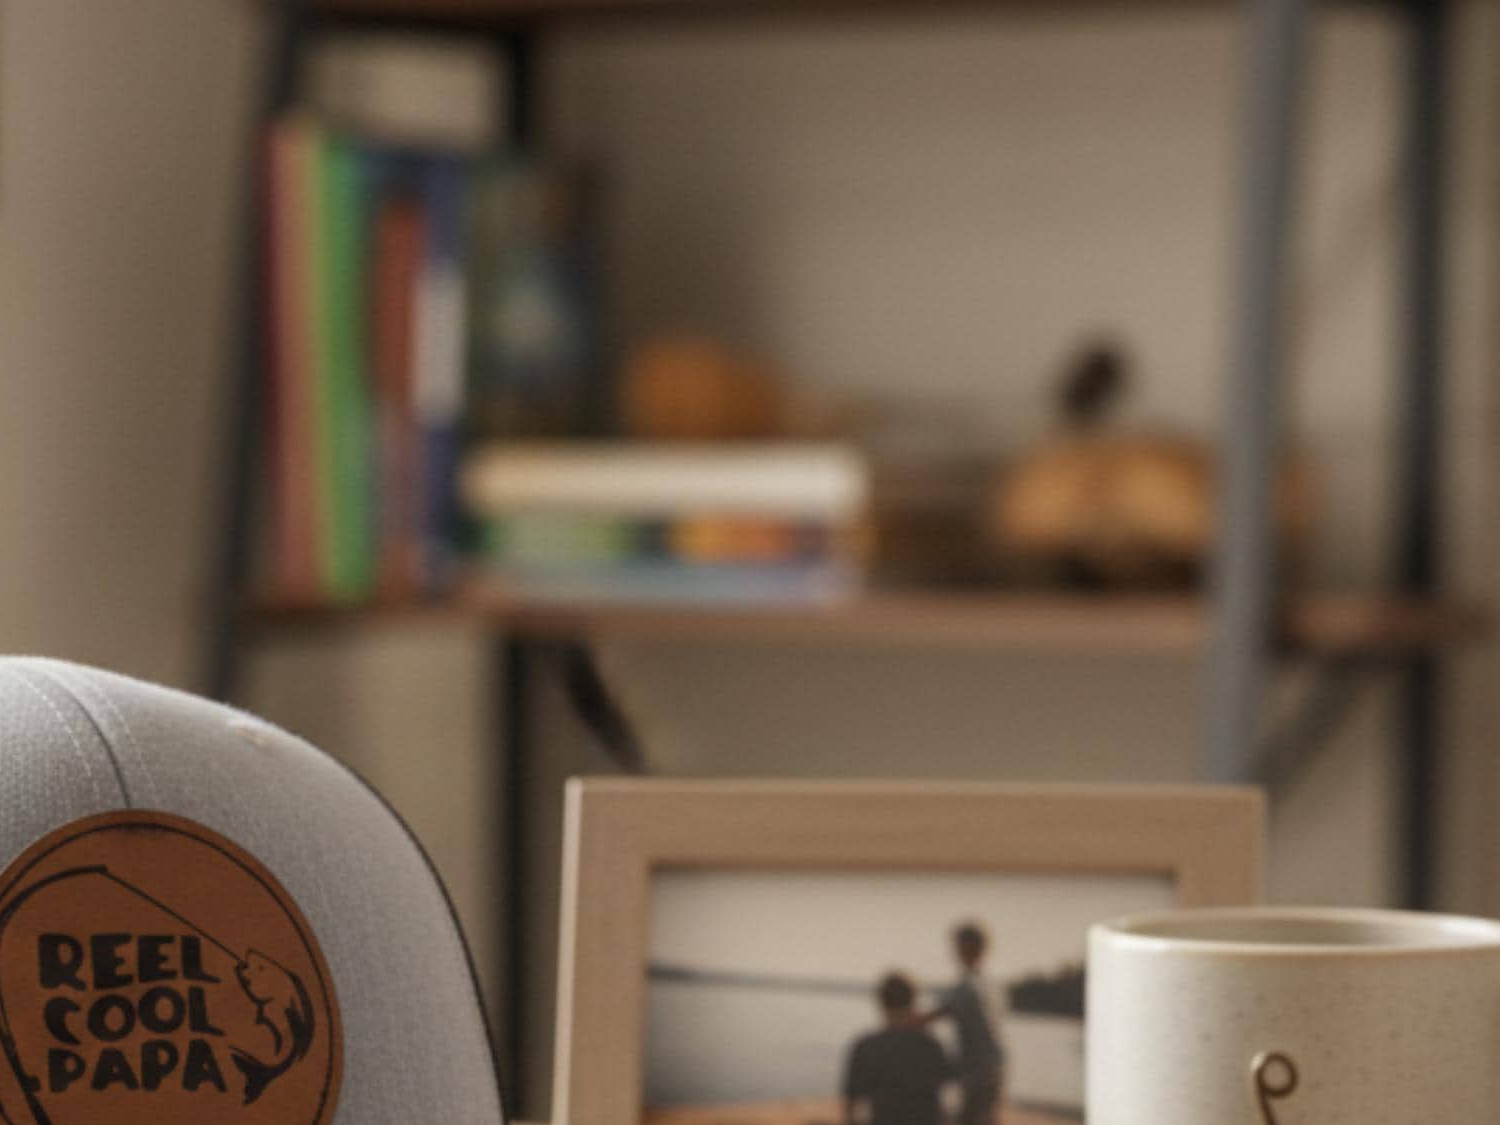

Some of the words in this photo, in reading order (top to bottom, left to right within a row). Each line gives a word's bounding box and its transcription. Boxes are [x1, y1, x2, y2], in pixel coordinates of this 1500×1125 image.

[37, 932, 222, 992] REEL
[43, 985, 226, 1046] COOL
[47, 1039, 229, 1094] PAPA
